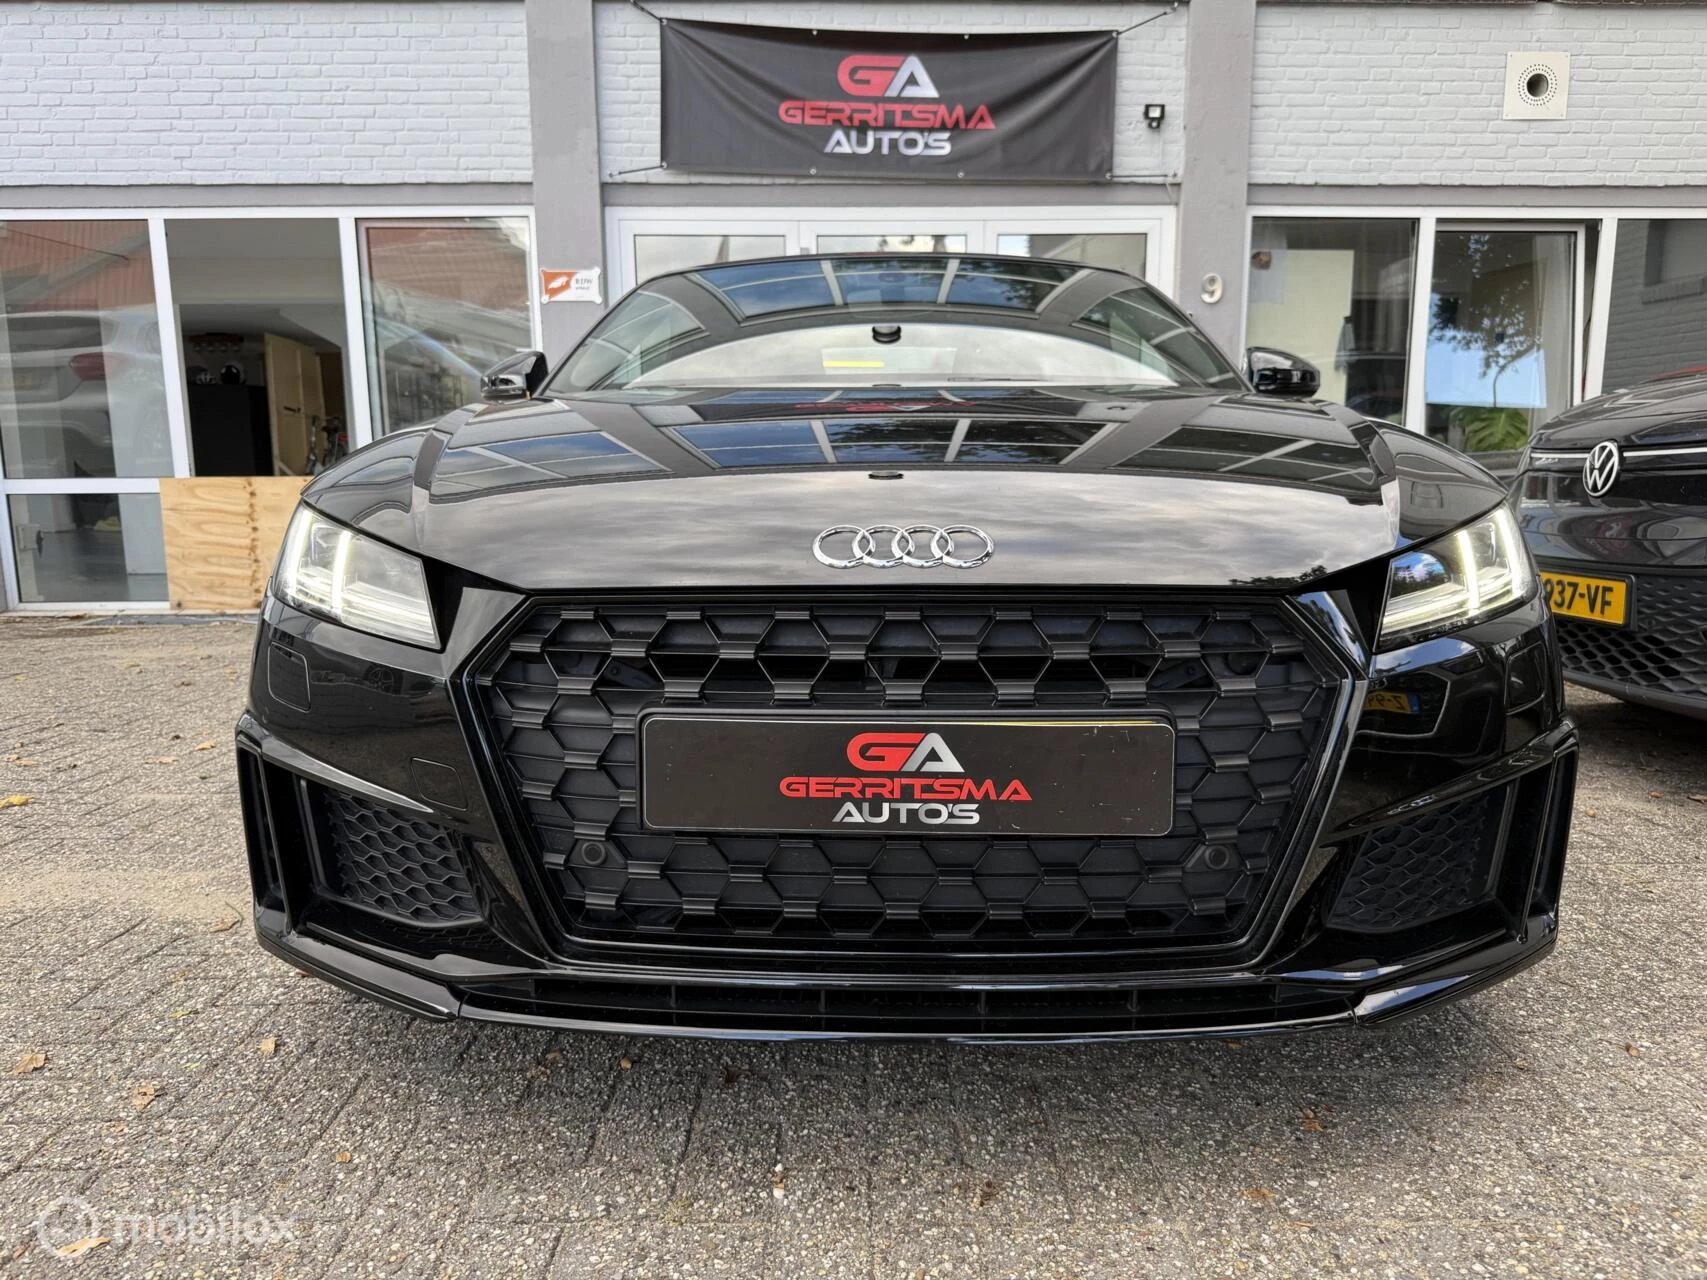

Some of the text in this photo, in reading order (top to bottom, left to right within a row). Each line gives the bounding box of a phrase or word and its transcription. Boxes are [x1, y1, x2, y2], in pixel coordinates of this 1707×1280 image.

[837, 54, 940, 98] GA
[778, 100, 996, 129] GERRITSMA
[824, 128, 952, 156] AUTO'S
[1200, 273, 1223, 304] 9
[847, 732, 965, 772] GA
[779, 776, 1032, 801] GERRITSMA
[832, 801, 980, 825] AUTO'S
